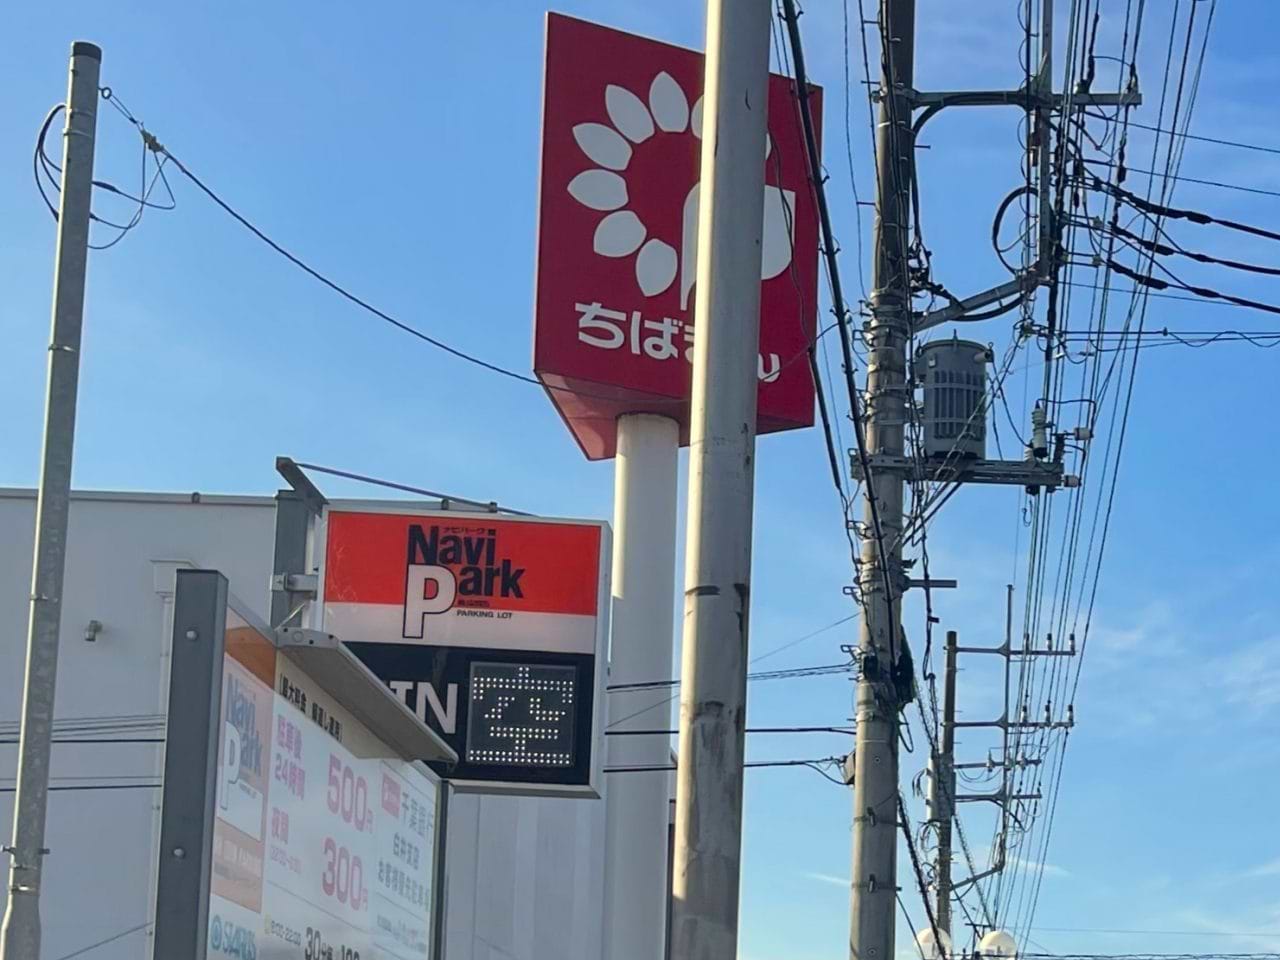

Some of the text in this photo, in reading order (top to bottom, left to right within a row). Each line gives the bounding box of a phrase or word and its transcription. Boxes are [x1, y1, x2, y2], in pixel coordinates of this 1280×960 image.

[408, 524, 496, 567] Navi
[402, 559, 526, 639] Park
[456, 609, 494, 618] PARKING
[470, 666, 573, 765] 空
[275, 752, 374, 835] 24時間 500円
[322, 837, 369, 914] 300円
